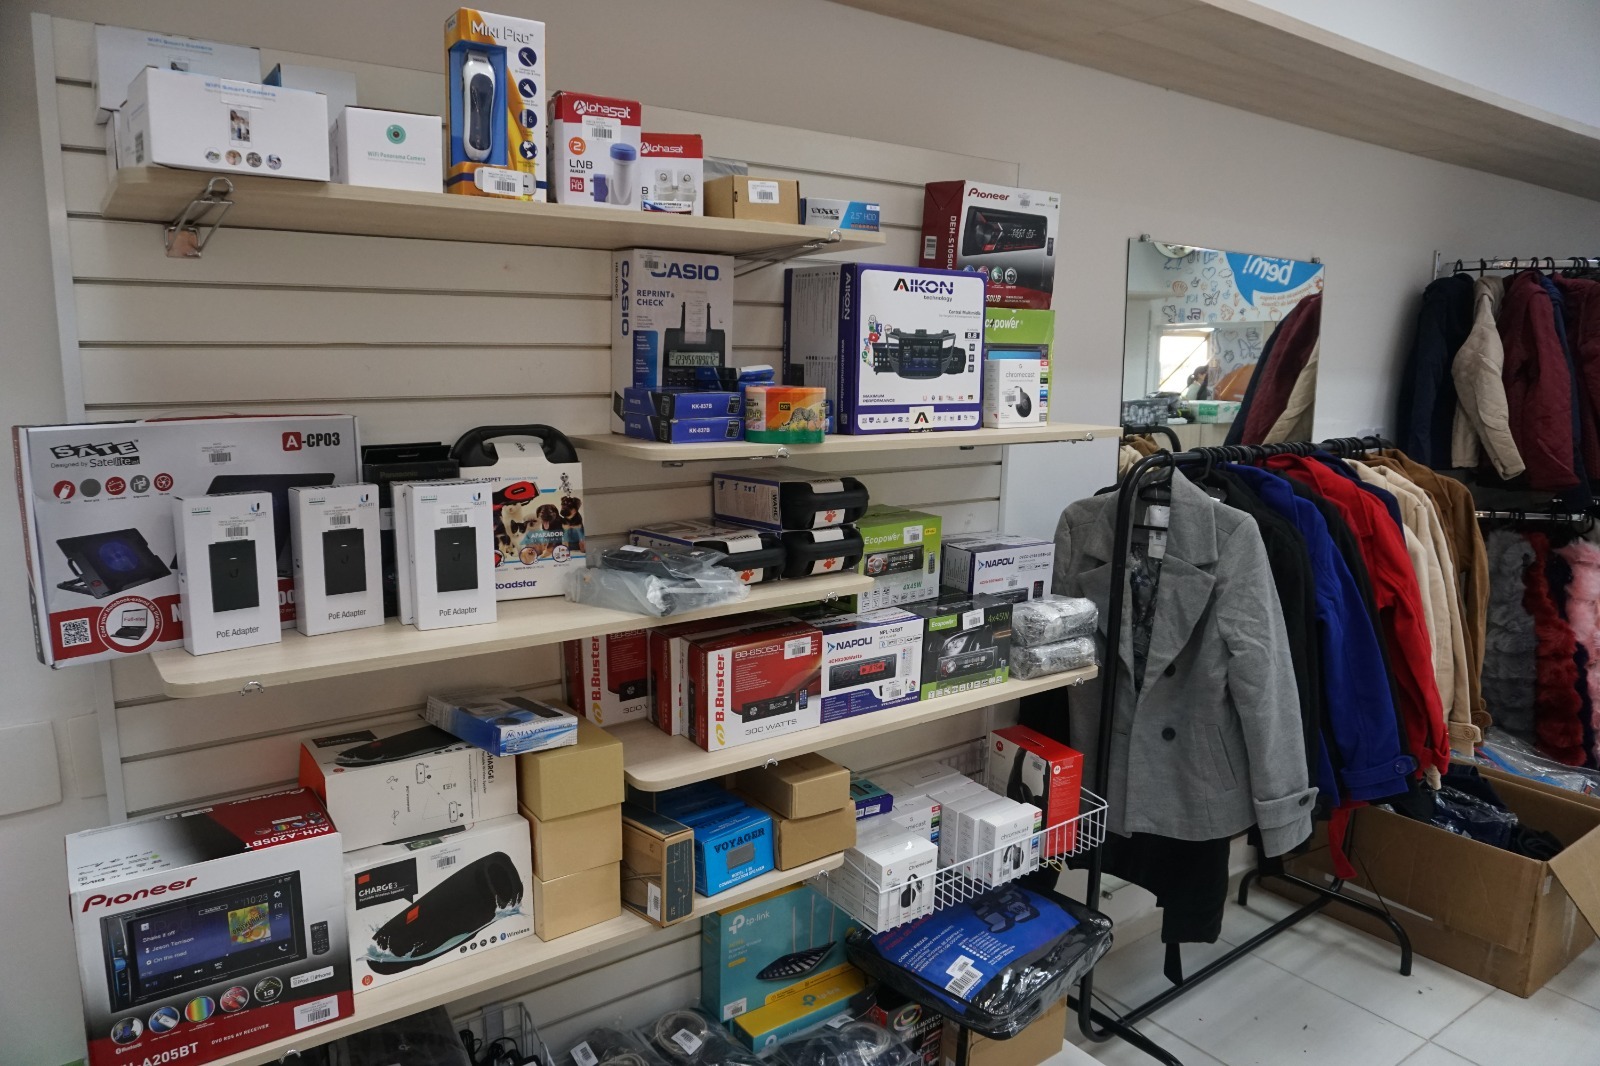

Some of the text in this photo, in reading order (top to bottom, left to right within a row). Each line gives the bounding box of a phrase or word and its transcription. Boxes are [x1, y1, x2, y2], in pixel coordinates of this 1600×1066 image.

[569, 158, 593, 170] LNB
[968, 188, 1010, 202] Pioneer
[893, 278, 954, 294] AIKON
[636, 290, 670, 298] REPRINT
[636, 298, 664, 306] CHECK
[864, 532, 902, 545] Ecopower
[985, 557, 1014, 568] NAPOLI
[328, 608, 366, 620] PoE Adapter
[439, 606, 477, 616] PoE Adapter
[216, 625, 259, 638] PoE Adapter
[836, 636, 872, 650] NAPOLI
[715, 654, 725, 722] B.Buster
[745, 718, 798, 736] 300 WATTS
[714, 827, 765, 854] VOYAGER
[82, 876, 197, 913] Pioneer
[358, 882, 393, 898] CHARGE
[507, 926, 530, 939] Wireless
[244, 1024, 269, 1037] RECEIVER
